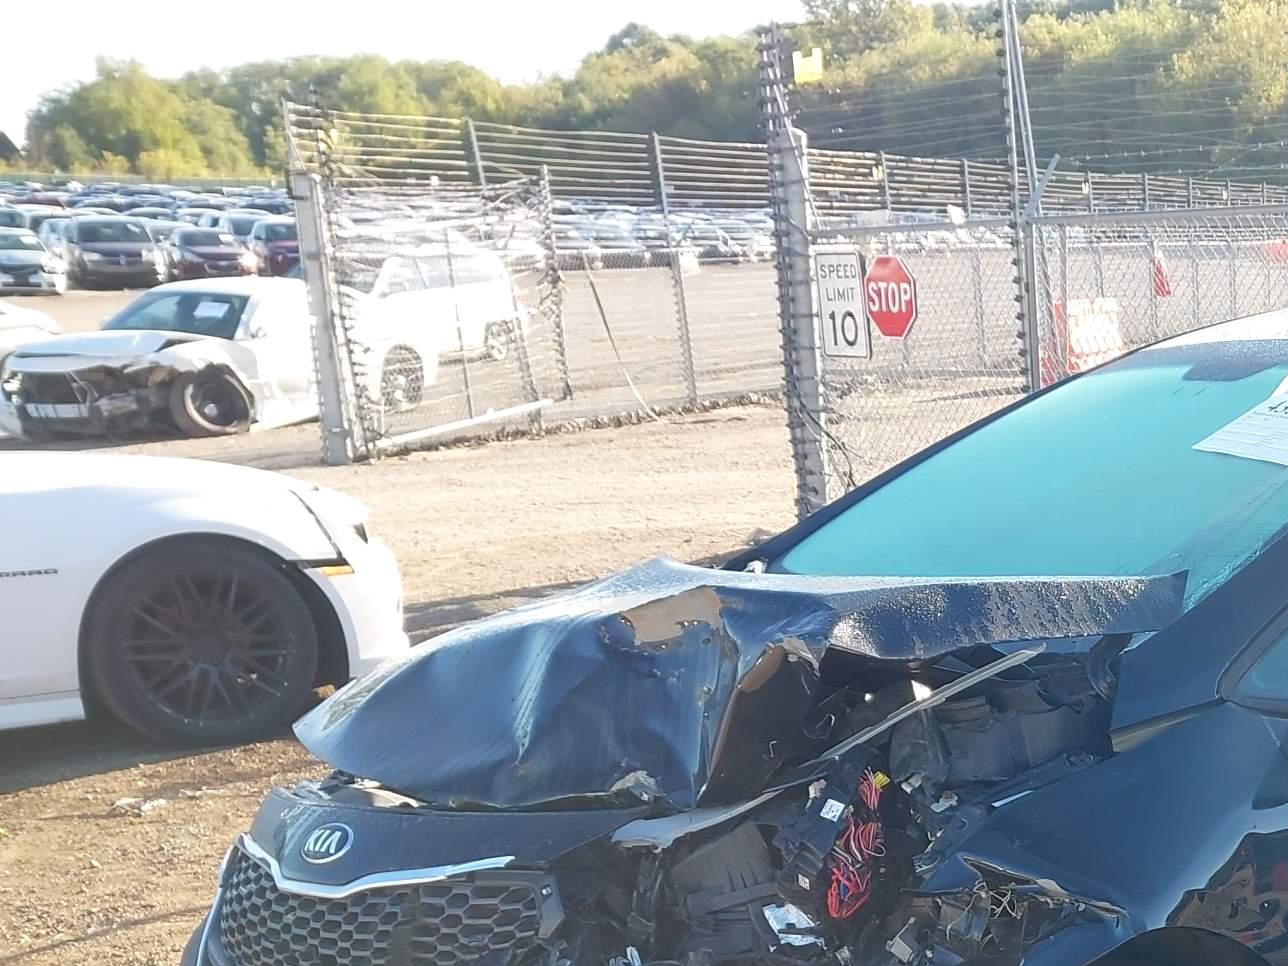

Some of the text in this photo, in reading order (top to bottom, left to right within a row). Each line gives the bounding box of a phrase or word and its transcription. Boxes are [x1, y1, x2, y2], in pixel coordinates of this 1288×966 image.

[819, 263, 857, 279] SPEED
[825, 287, 856, 302] LIMIT
[868, 281, 911, 313] STOP
[828, 310, 858, 347] 10
[304, 828, 343, 854] KIA
